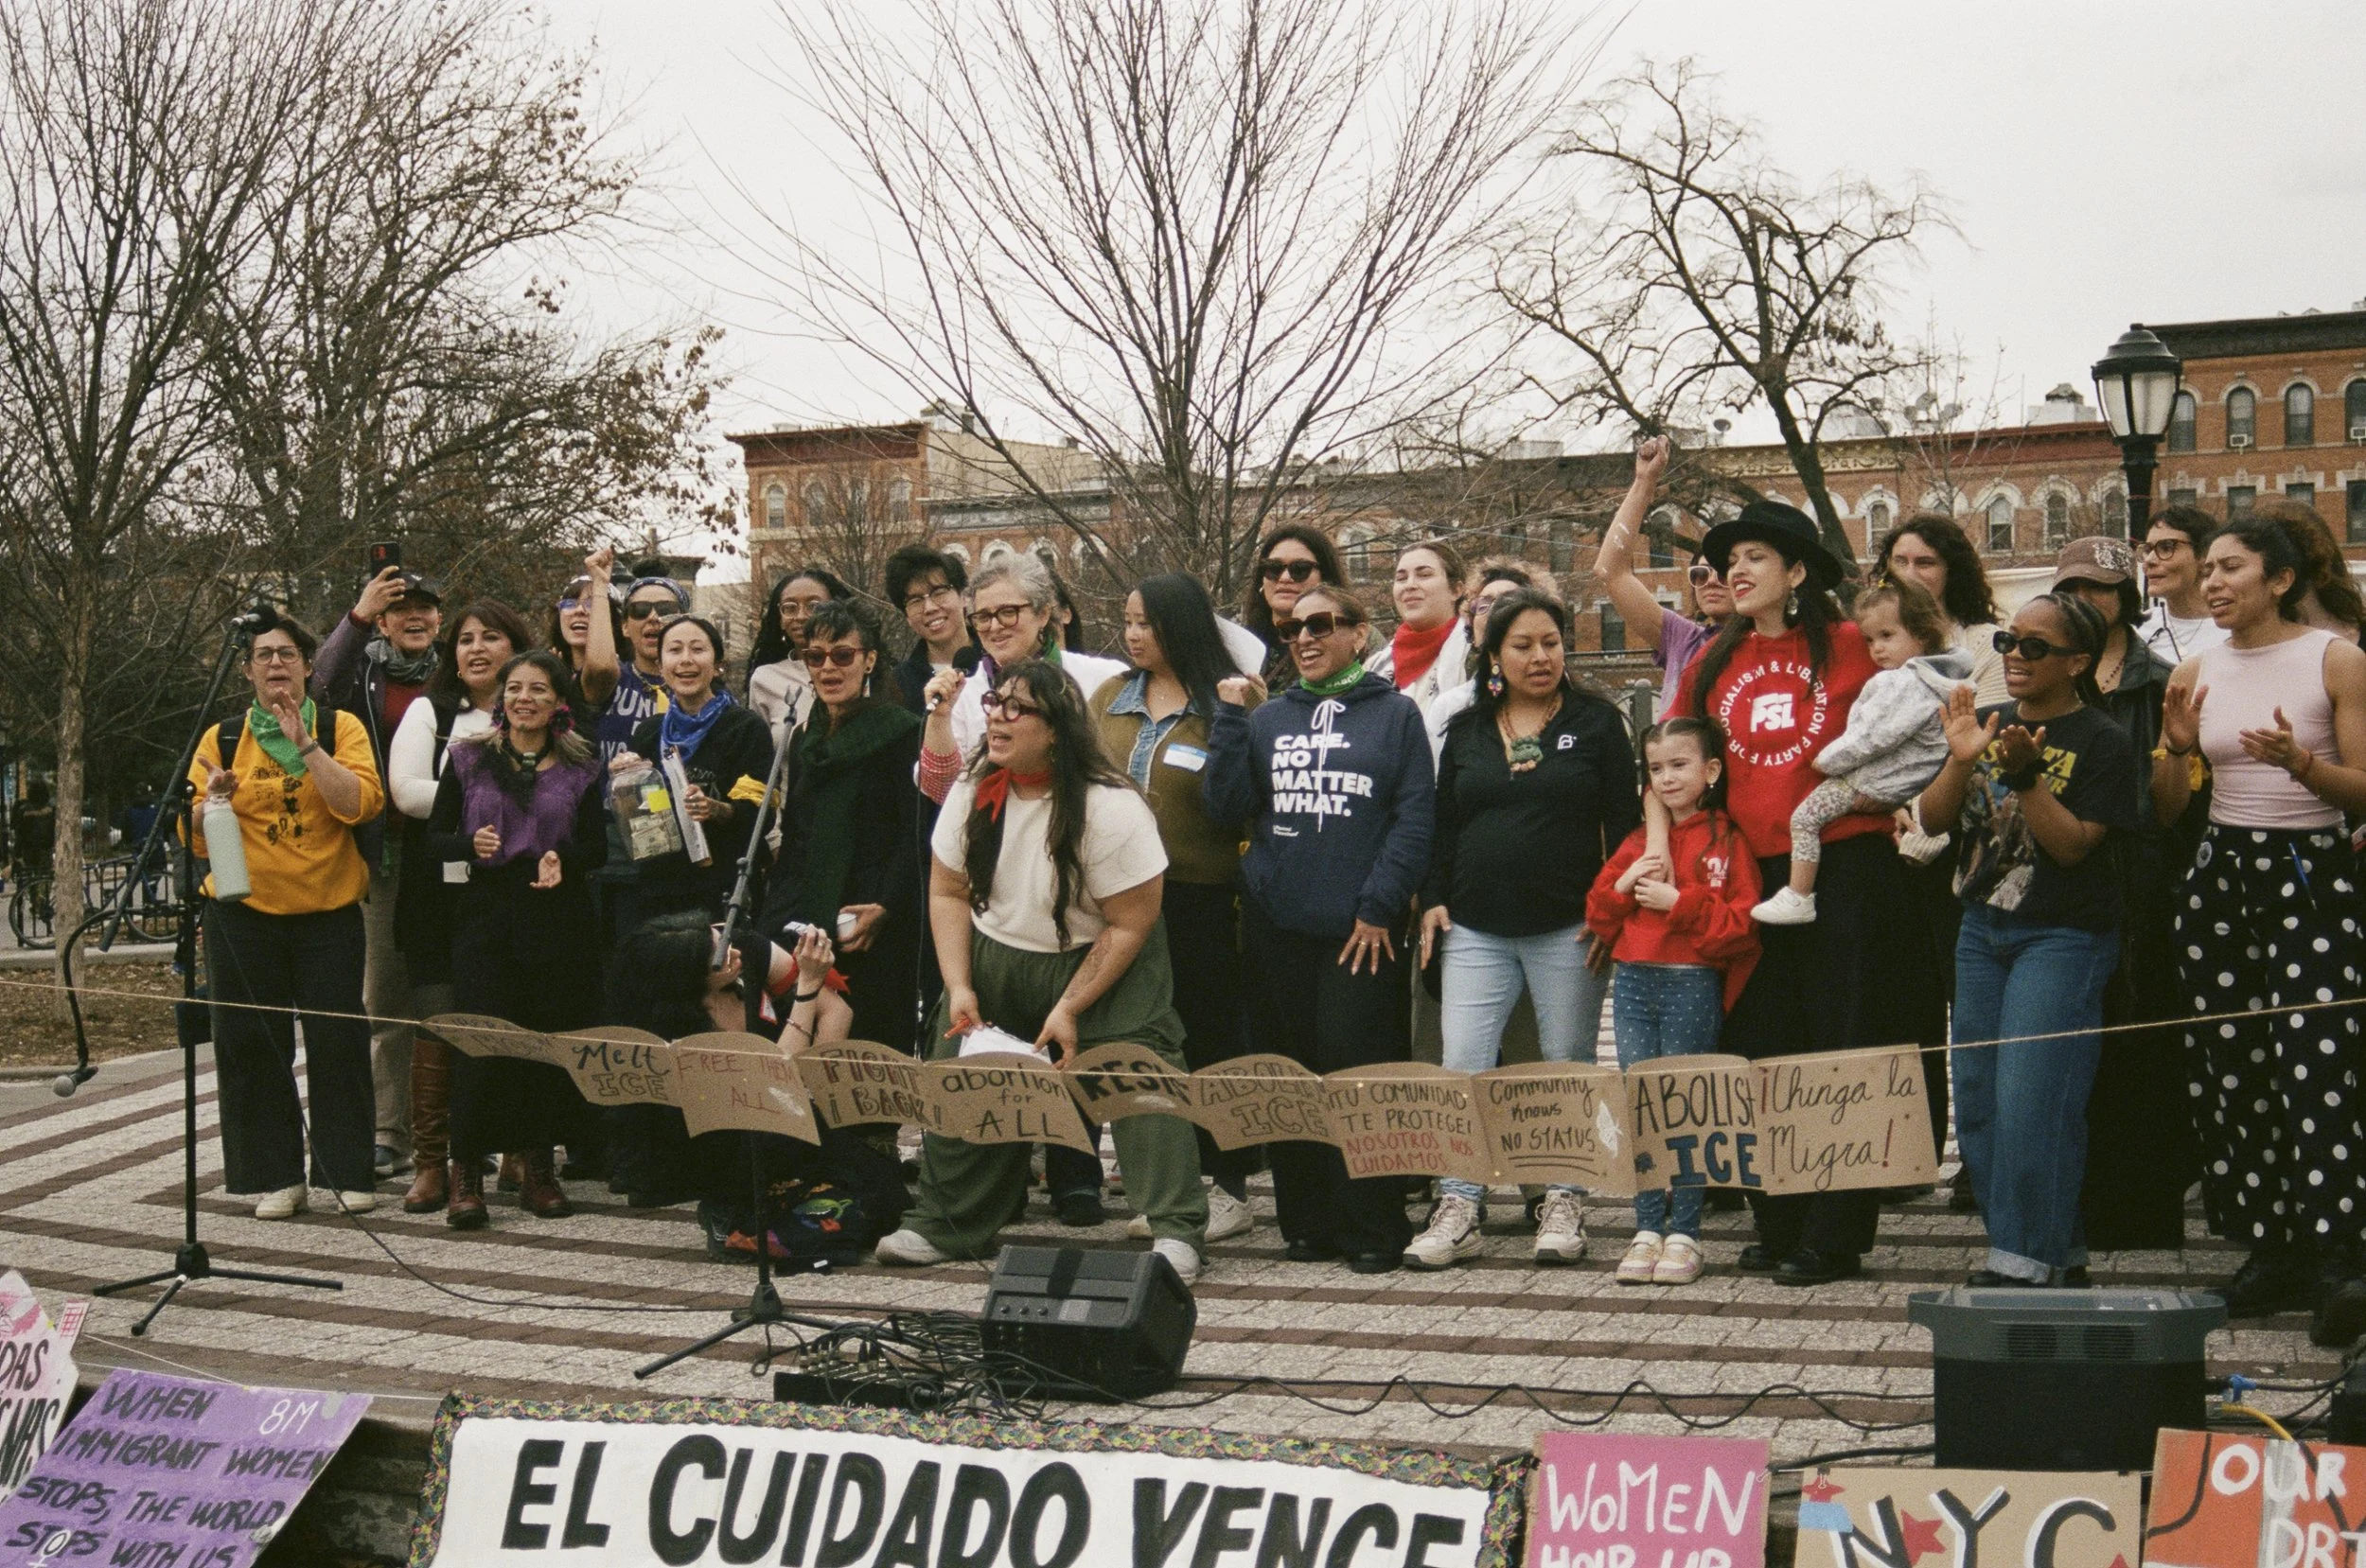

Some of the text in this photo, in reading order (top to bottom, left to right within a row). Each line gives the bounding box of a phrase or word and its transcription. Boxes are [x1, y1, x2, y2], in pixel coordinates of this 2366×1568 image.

[1770, 661, 1780, 673] &
[1786, 662, 1827, 735] LIBRATION
[1274, 733, 1351, 750] CARE.
[1764, 736, 1811, 766] PARTY
[1272, 749, 1312, 770] NO
[1272, 770, 1373, 798] MATTER
[1273, 792, 1351, 818] WHAT.
[572, 1041, 670, 1076] Melt
[677, 1051, 744, 1080] FREE
[820, 1049, 920, 1096] FIGHT
[592, 1072, 669, 1101] ICE
[1885, 1053, 1918, 1099] la
[732, 1086, 781, 1114] ALL
[998, 1088, 1034, 1105] for
[1370, 1083, 1467, 1110] COMUNIDAD
[976, 1109, 1065, 1138] ALL
[1230, 1096, 1329, 1136] ICE
[1340, 1113, 1372, 1133] TE
[1346, 1132, 1440, 1155] NOSOTROS
[1501, 1132, 1522, 1152] NO
[1769, 1118, 1894, 1191] Migra!
[1666, 1131, 1762, 1189] ICE
[101, 1381, 218, 1421] WHEN
[259, 1399, 318, 1435] 8M
[53, 1427, 335, 1481] IMMIGRANT WOMEN
[2211, 1443, 2346, 1503] OUR
[125, 1489, 190, 1524] THE
[187, 1500, 288, 1533] WORLD
[501, 1439, 610, 1549] EL
[649, 1434, 1091, 1568] CUIDADO
[1546, 1460, 1756, 1536] WOMEN
[1827, 1486, 2117, 1568] NYC
[110, 1537, 190, 1568] WITH
[191, 1544, 238, 1568] US
